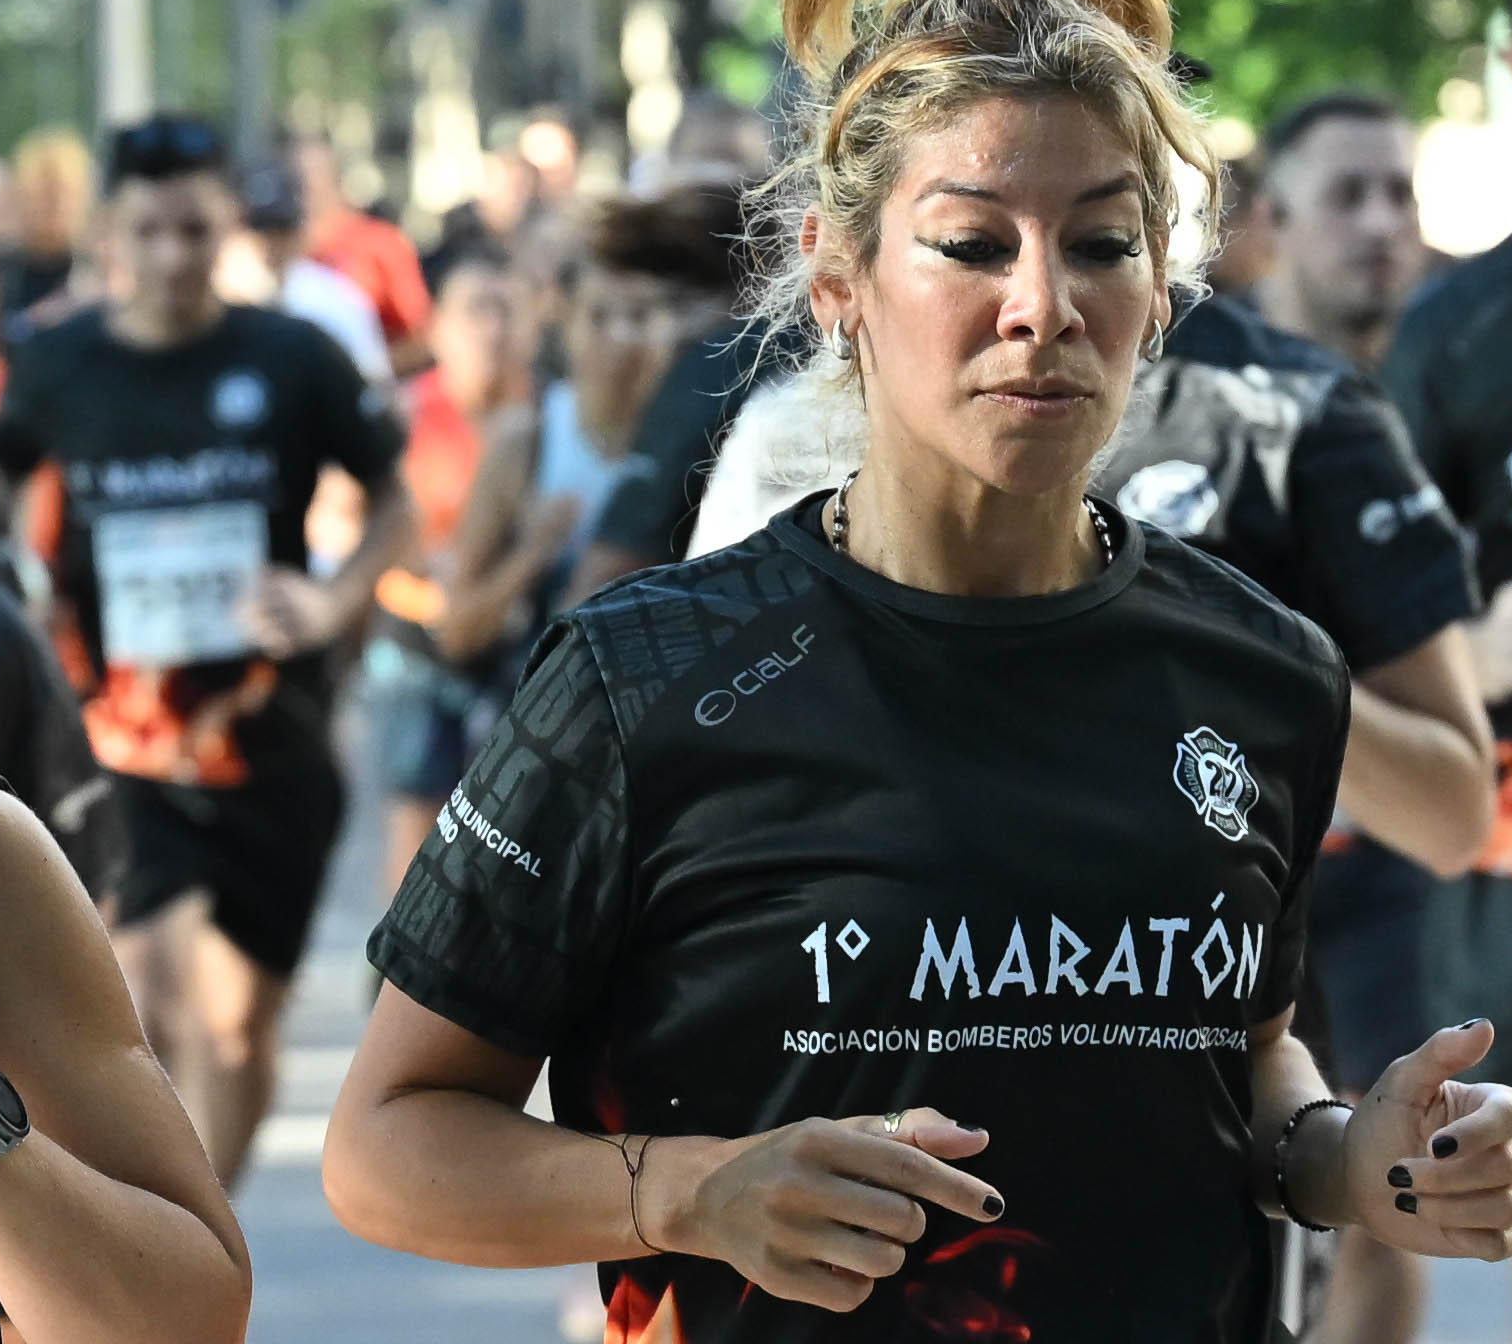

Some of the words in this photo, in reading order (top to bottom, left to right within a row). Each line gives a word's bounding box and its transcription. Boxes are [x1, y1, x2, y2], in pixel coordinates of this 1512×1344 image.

[455, 796, 541, 878] MUNICIPAL
[800, 918, 871, 1003] 1°
[908, 891, 1263, 1001] MARATÓN
[782, 1025, 919, 1055] ASOCIACIÓN
[927, 1024, 1053, 1053] BOMBEROS
